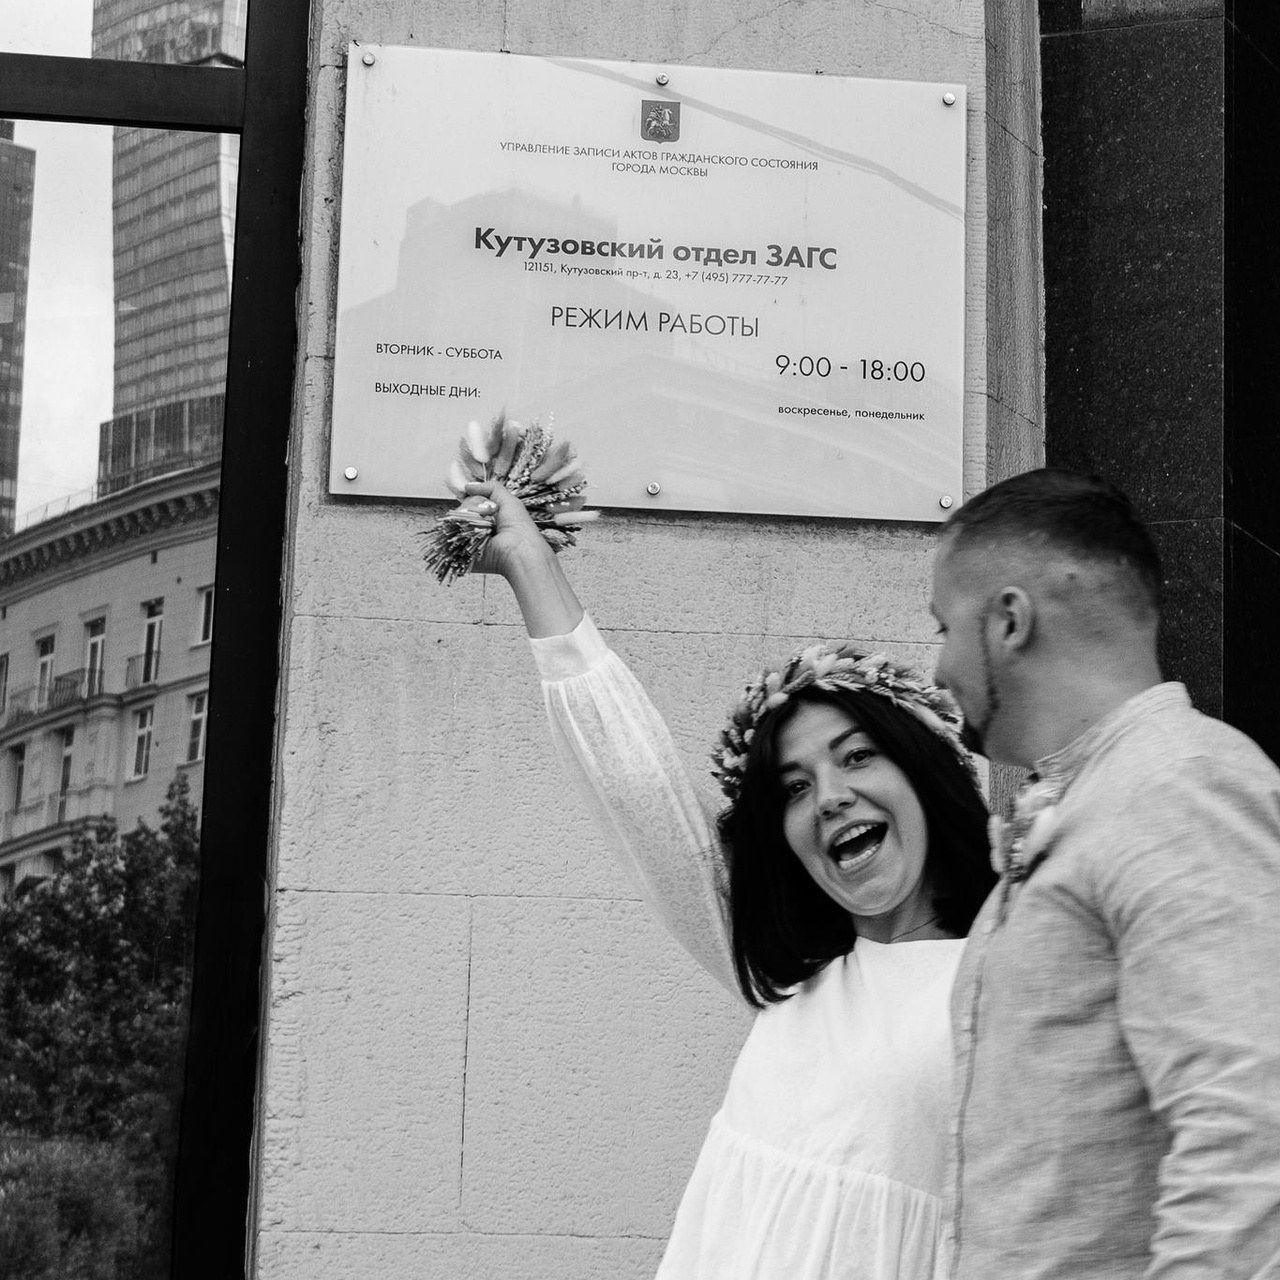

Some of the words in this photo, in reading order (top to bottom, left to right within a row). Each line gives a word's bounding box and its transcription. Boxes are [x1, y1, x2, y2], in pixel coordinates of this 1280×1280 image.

[499, 141, 571, 156] УПРАВЛЕНИЕ
[573, 146, 620, 158] ЗАПИСИ
[622, 150, 658, 161] АКТОВ
[660, 152, 748, 166] ГРАЖДАНСКОГО
[750, 157, 819, 170] СОСТОЯНИЯ
[611, 162, 656, 175] ГОРОДА
[659, 165, 708, 177] МОСКВЫ
[474, 227, 664, 259] Кутузовский
[672, 244, 757, 267] отдел
[765, 244, 838, 270] ЗАГС
[524, 261, 557, 274] 121151,
[560, 263, 623, 277] Кутузовский
[626, 270, 650, 279] пр-т,
[653, 271, 663, 280] д.
[665, 270, 682, 281] 23,
[685, 271, 699, 281] +7
[701, 271, 729, 284] (495)
[732, 273, 788, 286] 777-77-77
[551, 305, 648, 332] РЕЖИМ
[658, 312, 759, 338] РАБОТЫ
[376, 343, 435, 356] ВТОРНИК
[445, 346, 503, 360] СУББОТА
[775, 354, 832, 378] 9:00
[860, 358, 926, 383] 18:00
[375, 382, 446, 396] ВЫХОДНЫЕ
[448, 386, 481, 398] ДНИ:
[778, 406, 851, 418] воскресенье,
[854, 409, 926, 421] понедельник
